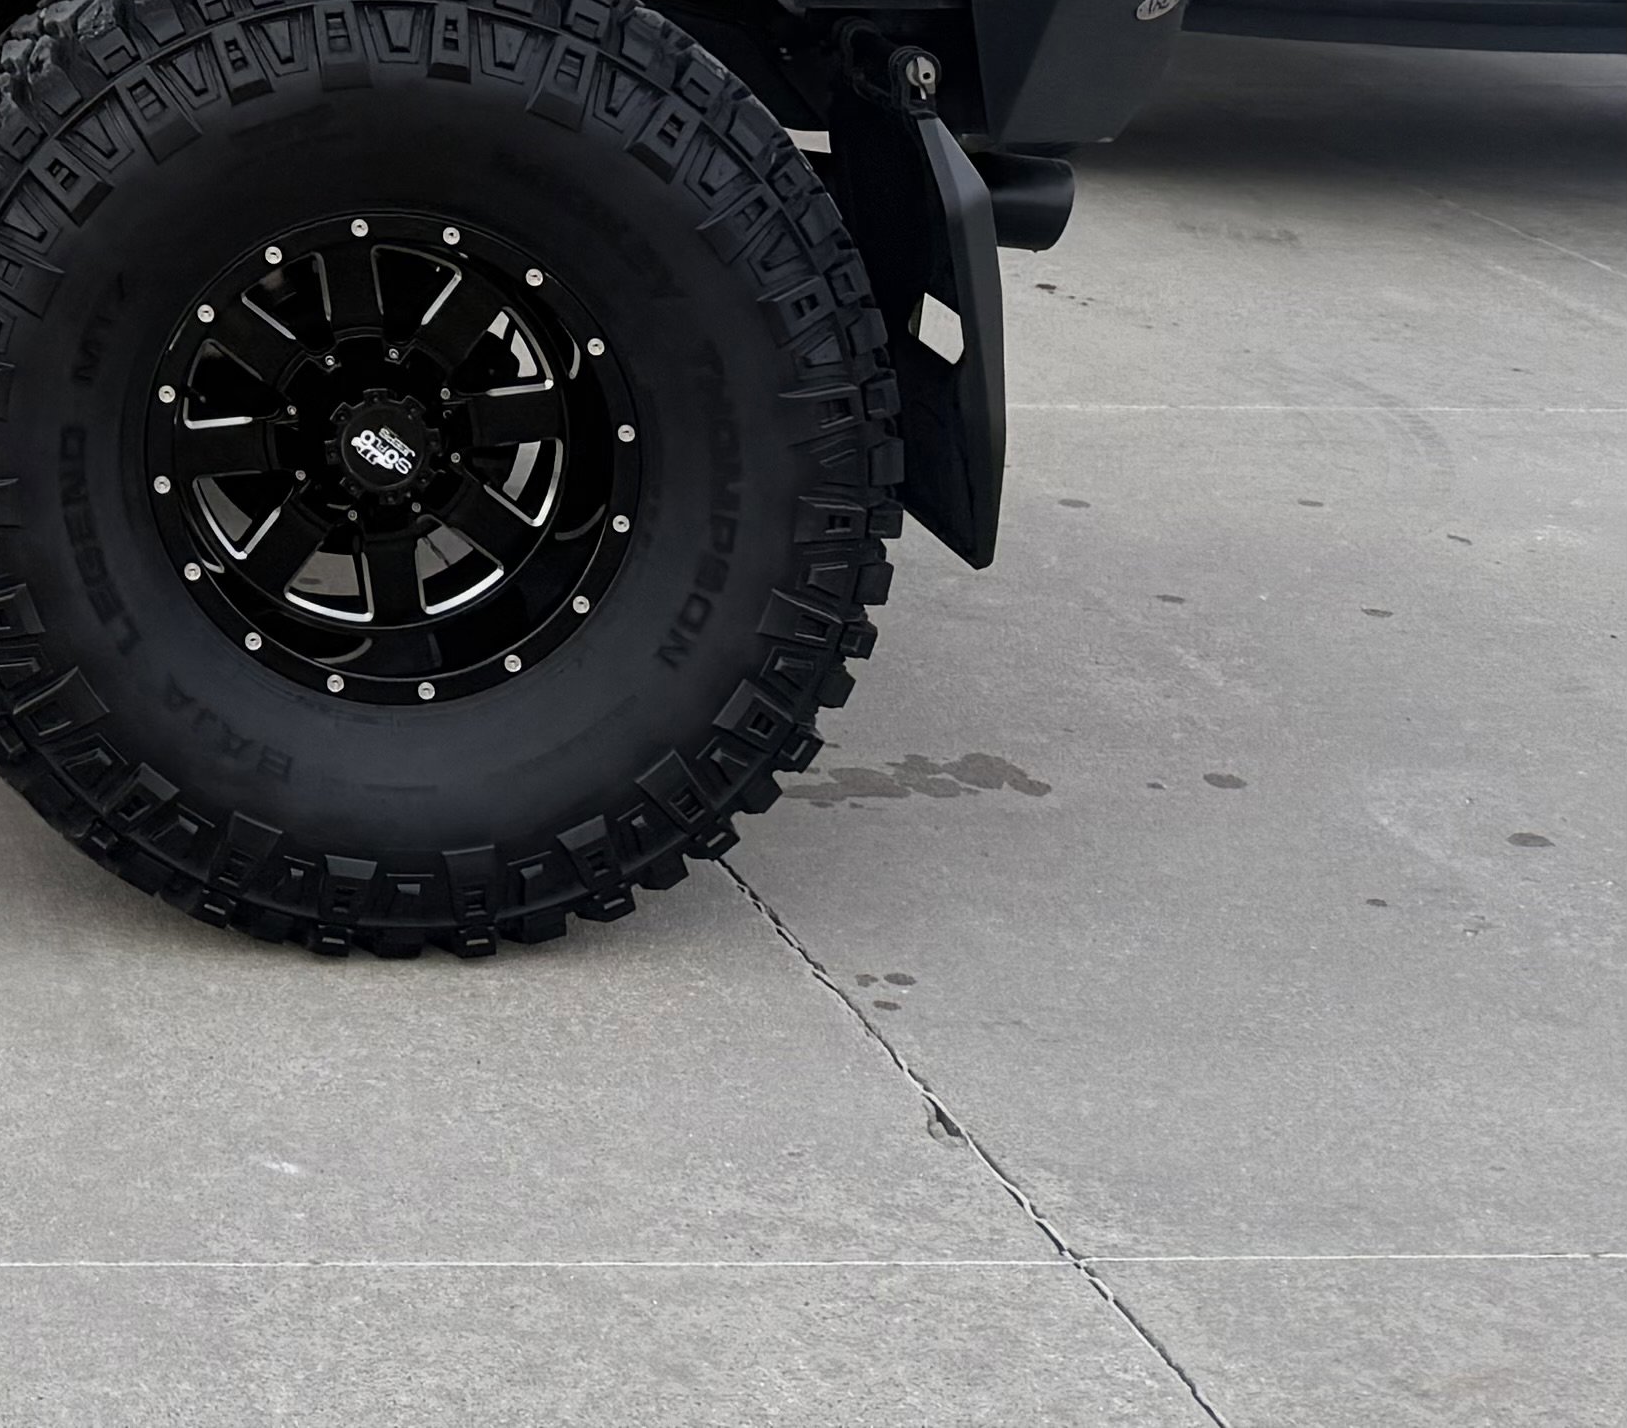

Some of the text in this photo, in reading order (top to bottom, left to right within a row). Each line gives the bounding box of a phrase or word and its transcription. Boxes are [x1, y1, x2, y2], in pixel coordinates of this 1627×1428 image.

[58, 270, 295, 782] BAJA LEGEND MTZ
